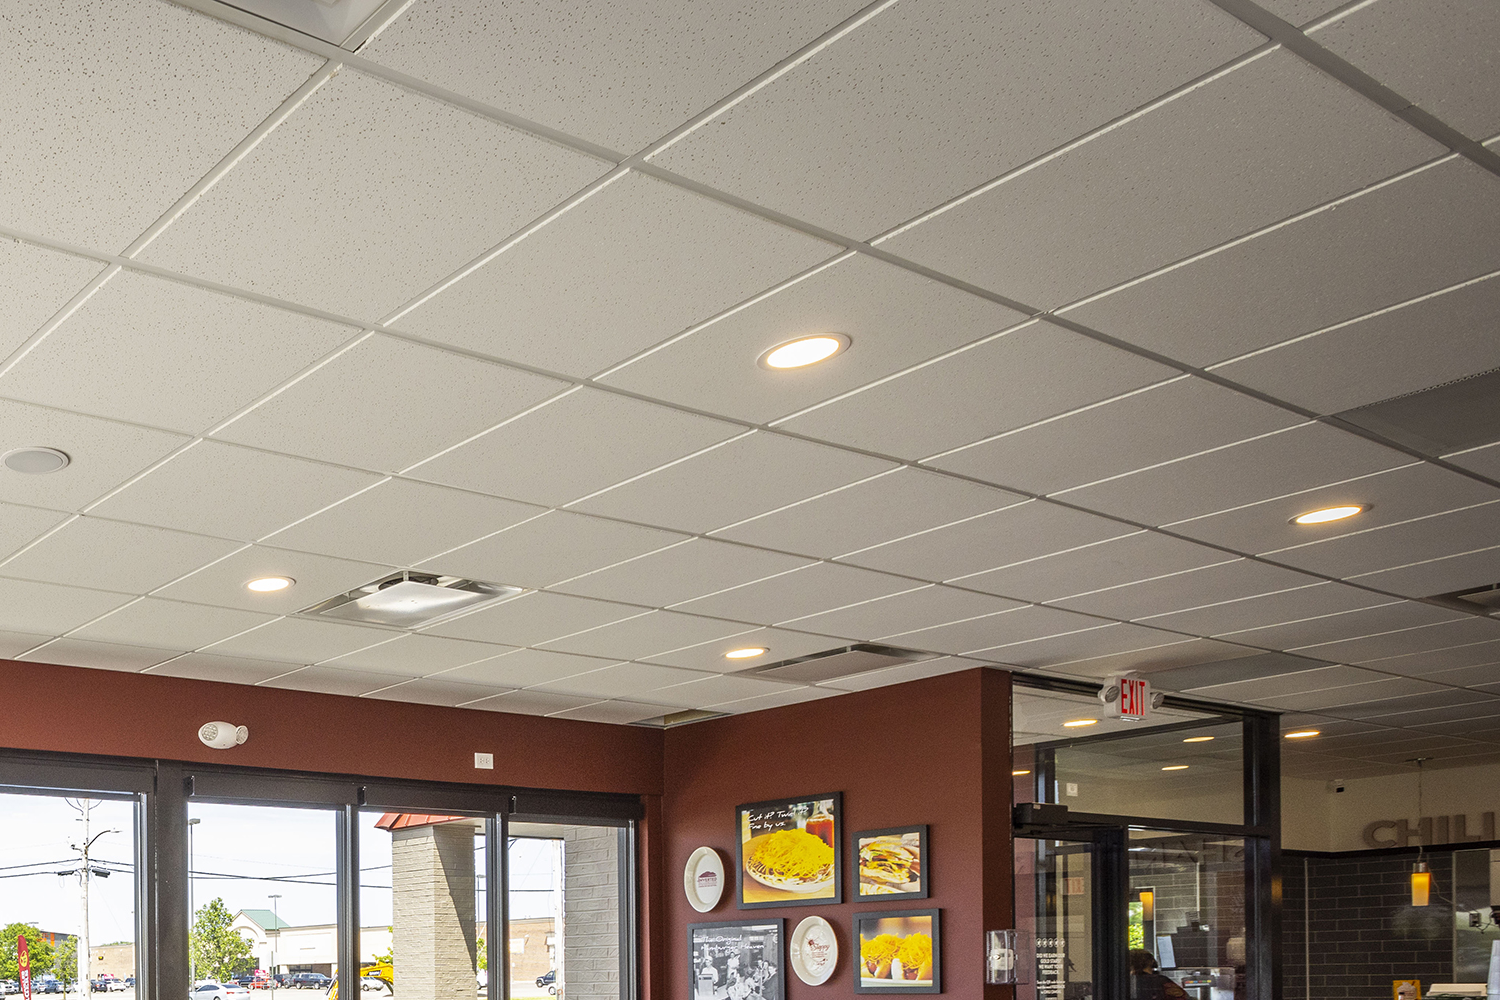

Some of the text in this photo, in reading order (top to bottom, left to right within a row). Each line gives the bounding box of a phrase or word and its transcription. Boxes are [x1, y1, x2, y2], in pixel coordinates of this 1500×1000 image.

[1121, 679, 1145, 715] EXIT
[764, 822, 773, 831] by
[1363, 812, 1494, 848] CHILI
